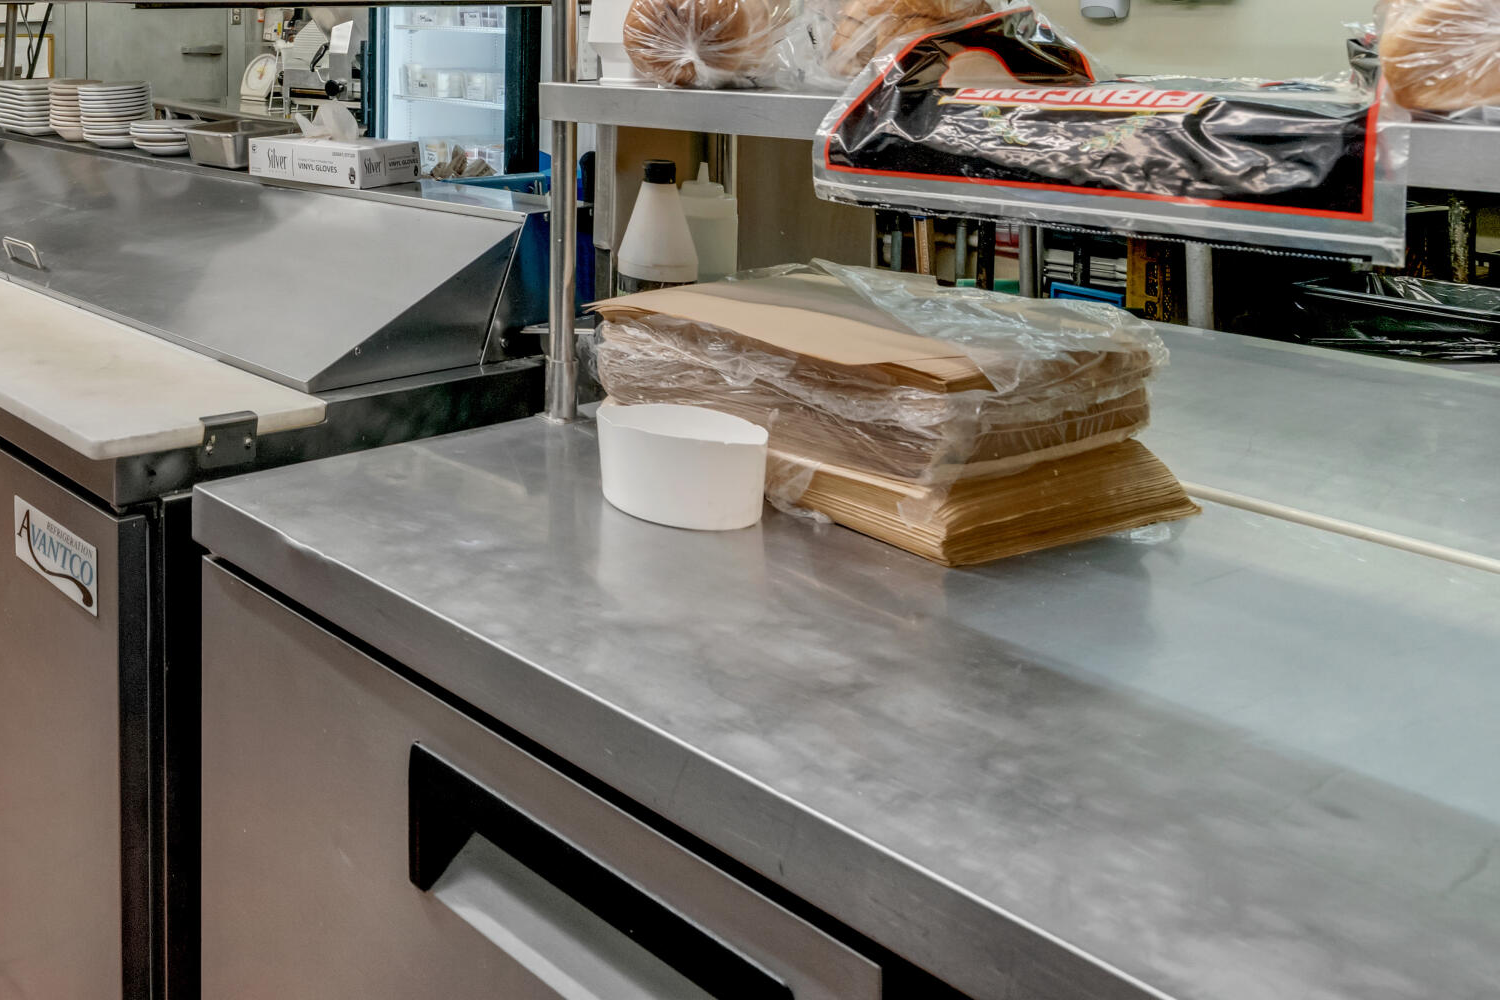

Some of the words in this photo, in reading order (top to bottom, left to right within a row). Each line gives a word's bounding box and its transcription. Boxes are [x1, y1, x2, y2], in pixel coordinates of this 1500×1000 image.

[267, 147, 288, 170] Silver
[297, 161, 315, 171] VINYL
[315, 164, 338, 174] GLOVES
[363, 157, 382, 175] Silver
[17, 509, 93, 605] AVANTCO
